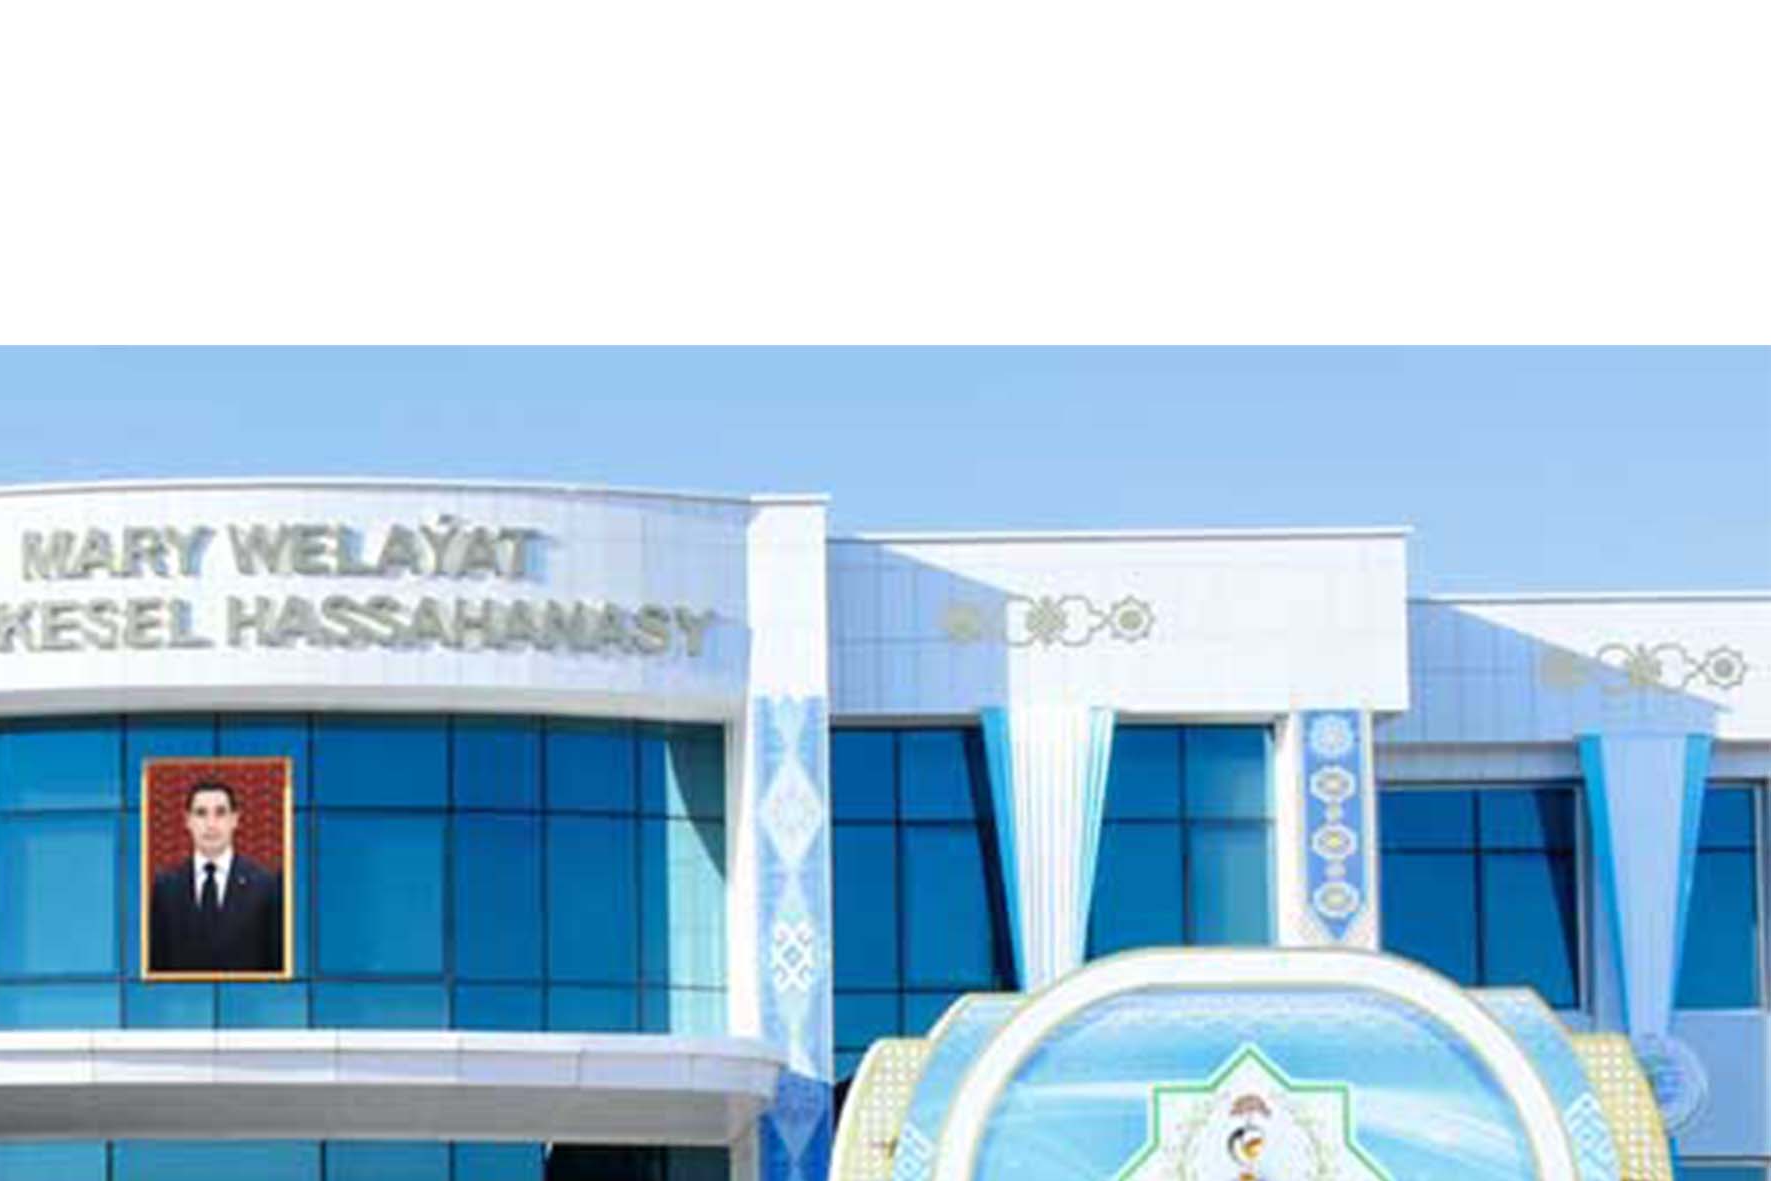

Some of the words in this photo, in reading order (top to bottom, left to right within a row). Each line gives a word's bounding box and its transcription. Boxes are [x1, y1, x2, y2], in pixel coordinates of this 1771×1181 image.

[21, 526, 214, 581] MARY
[226, 514, 542, 580] WELAÝAT
[226, 595, 716, 658] HASSAHANASY
